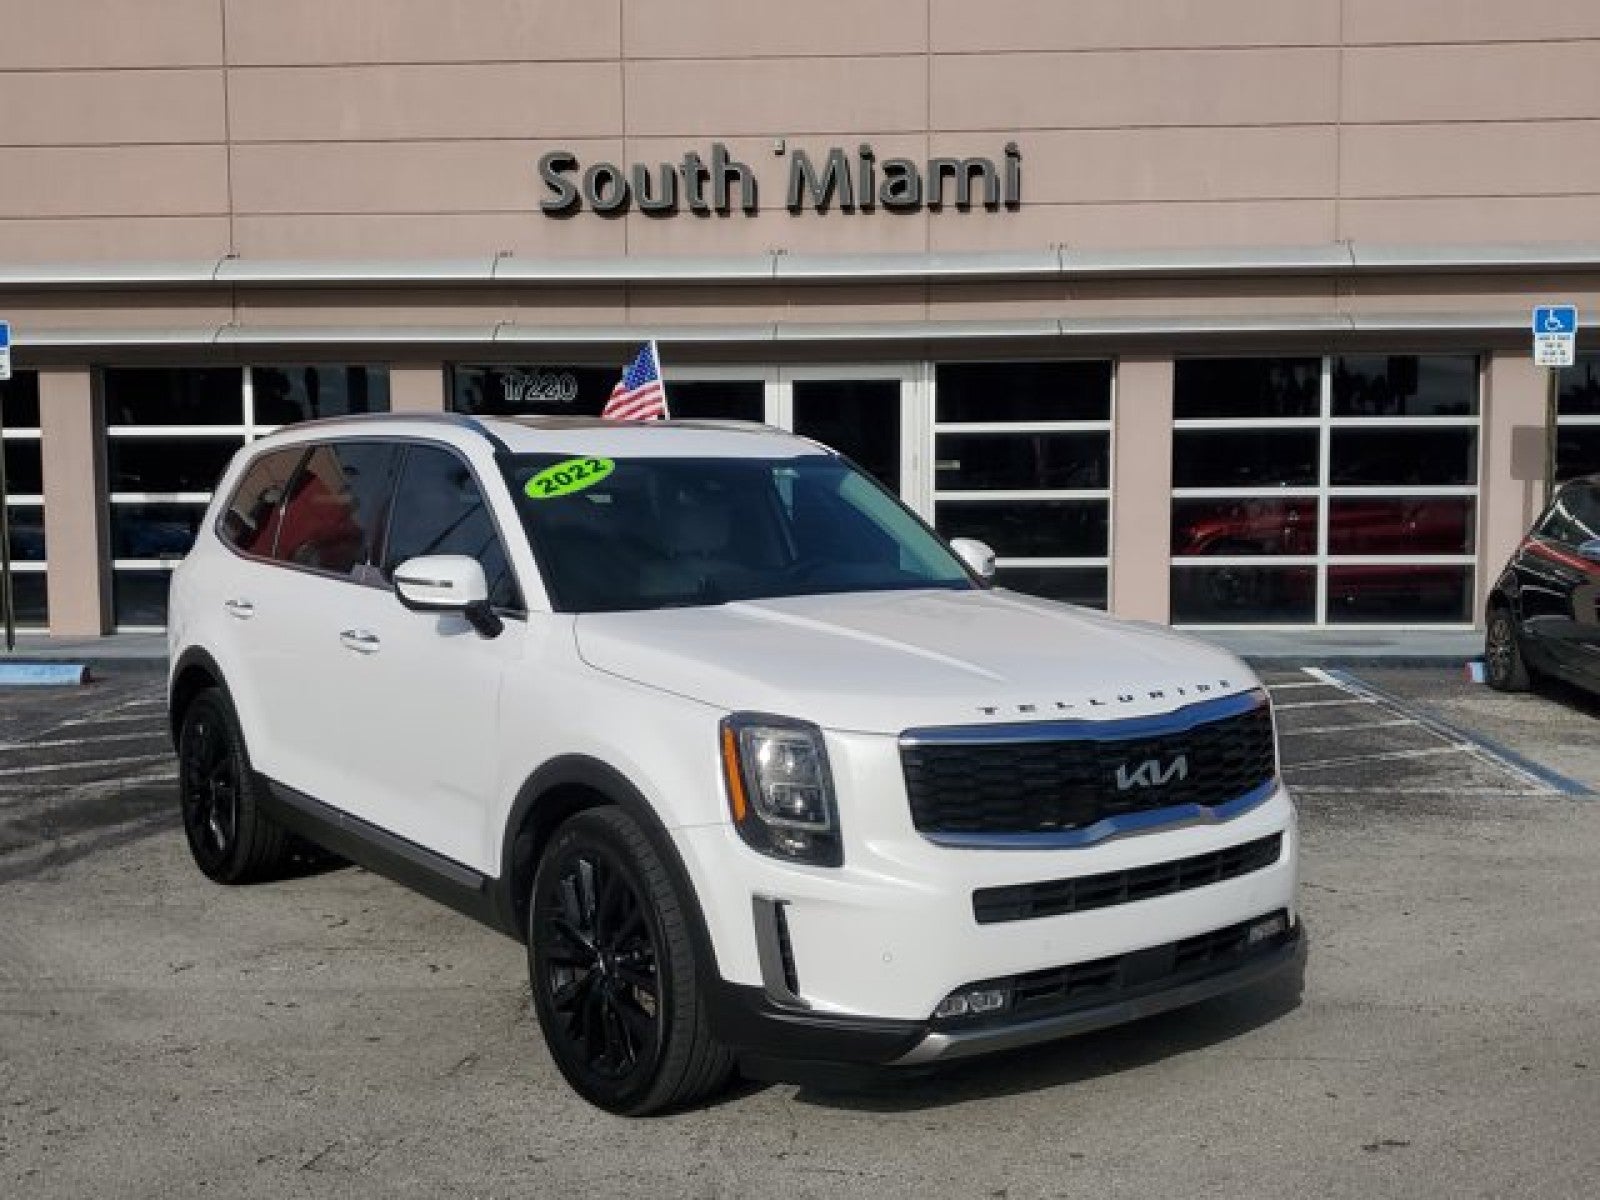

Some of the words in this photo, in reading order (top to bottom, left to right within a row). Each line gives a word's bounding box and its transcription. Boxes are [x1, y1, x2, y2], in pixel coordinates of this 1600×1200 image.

[538, 142, 757, 217] South
[787, 142, 1020, 214] Miami
[535, 459, 607, 495] 2022
[975, 680, 1232, 716] TELLURIDE
[1116, 755, 1189, 790] KIA
